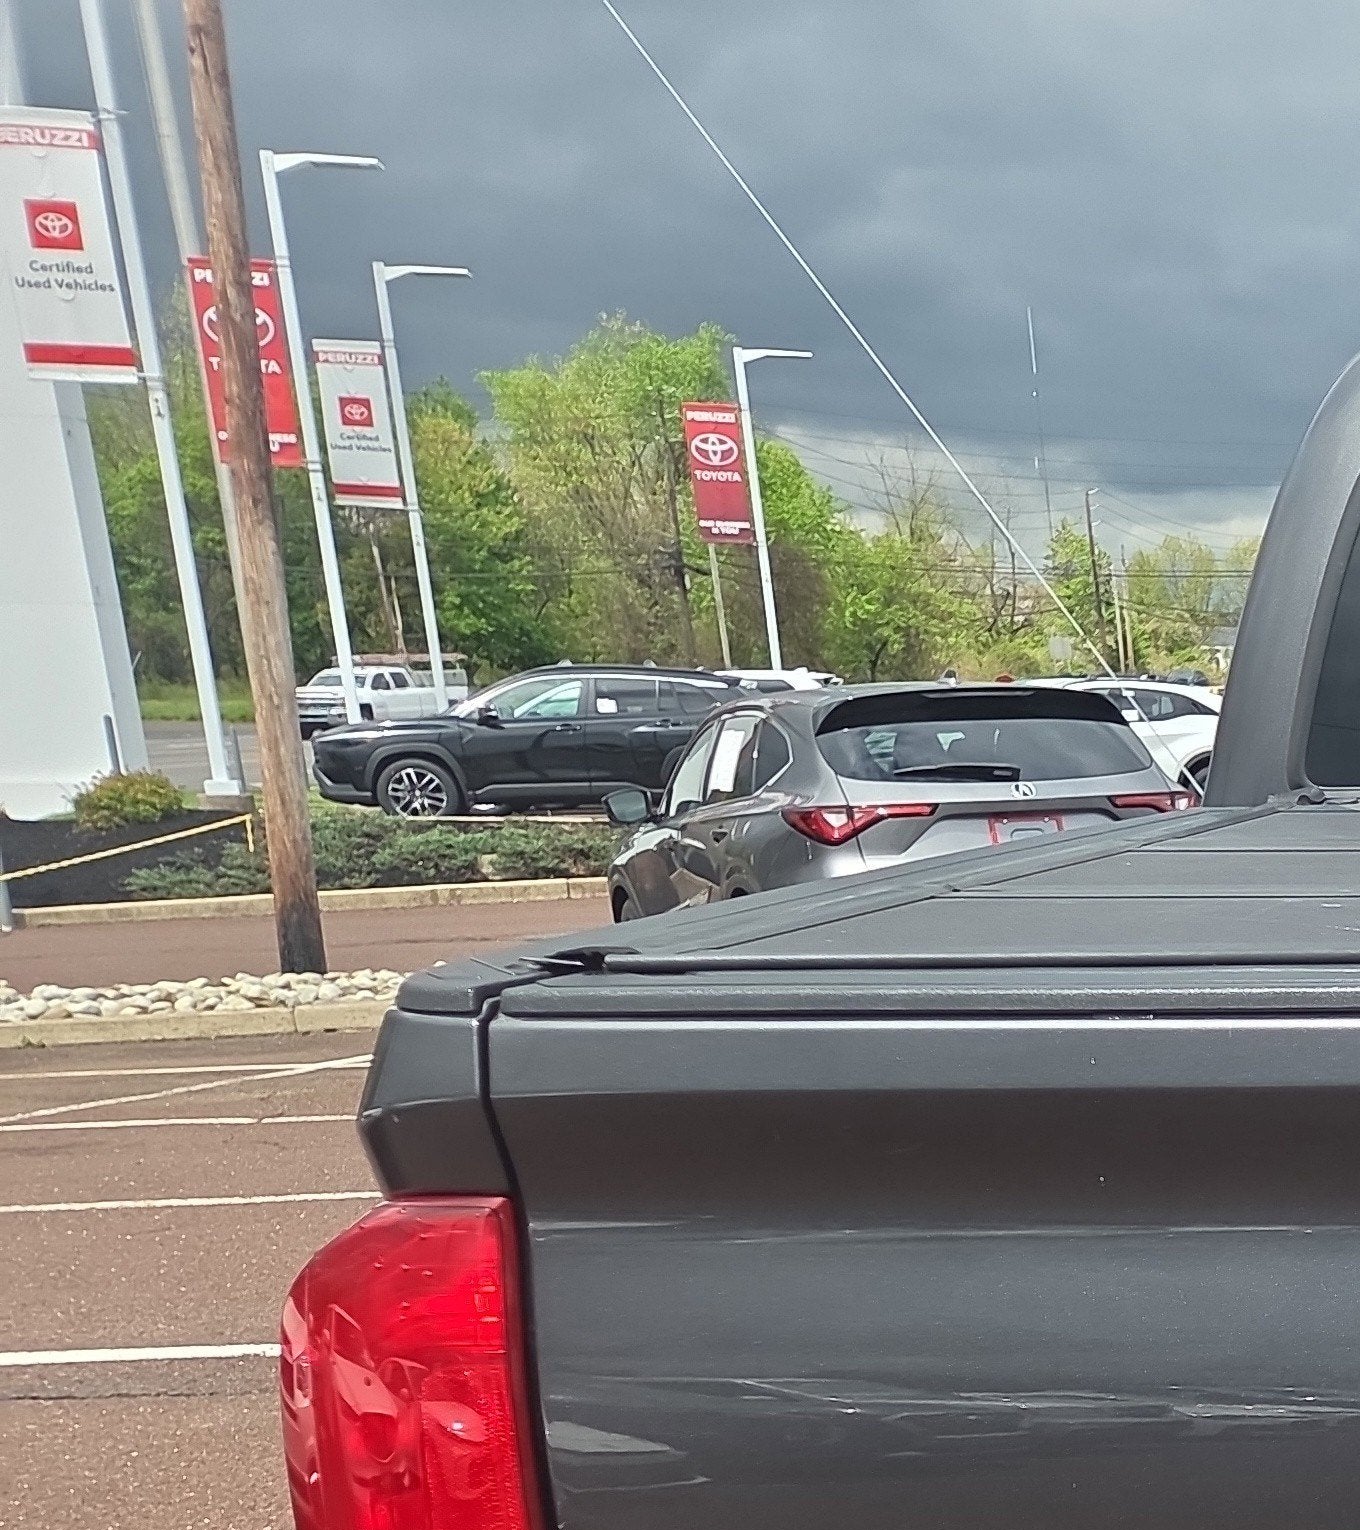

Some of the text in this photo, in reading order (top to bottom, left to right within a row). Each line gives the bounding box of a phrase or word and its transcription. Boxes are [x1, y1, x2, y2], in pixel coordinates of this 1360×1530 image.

[29, 259, 94, 274] Certified
[15, 276, 115, 292] Used Vehicles
[318, 352, 379, 365] PERUZZI
[694, 469, 742, 482] TOYOTA
